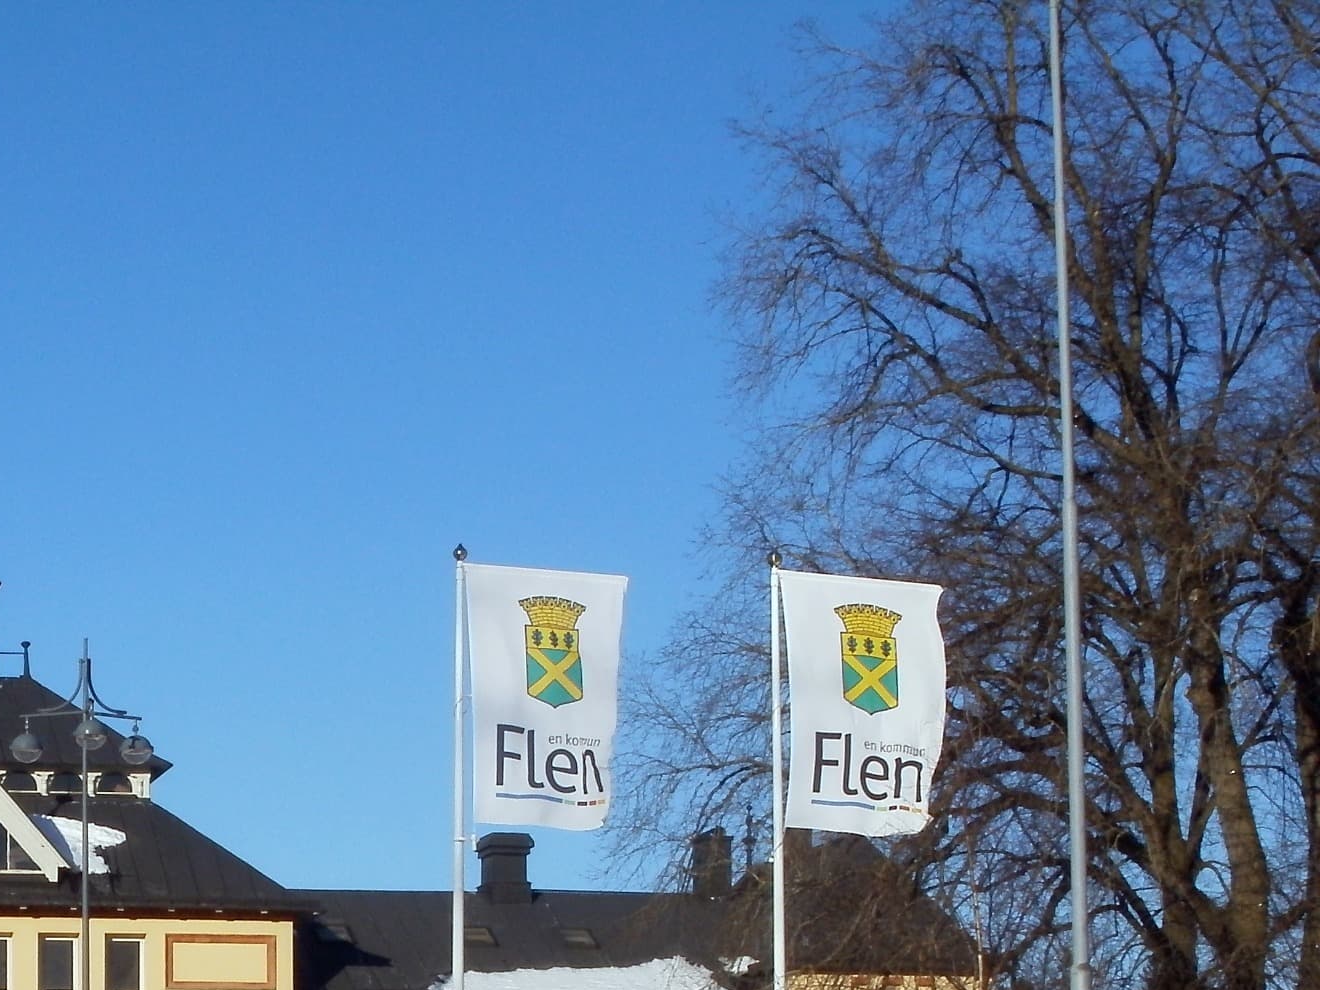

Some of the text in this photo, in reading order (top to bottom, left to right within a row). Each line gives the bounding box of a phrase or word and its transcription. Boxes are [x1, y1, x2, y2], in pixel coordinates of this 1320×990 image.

[496, 723, 604, 795] Flen
[548, 734, 562, 744] en
[864, 740, 926, 757] en kommun
[812, 731, 923, 803] Flen
